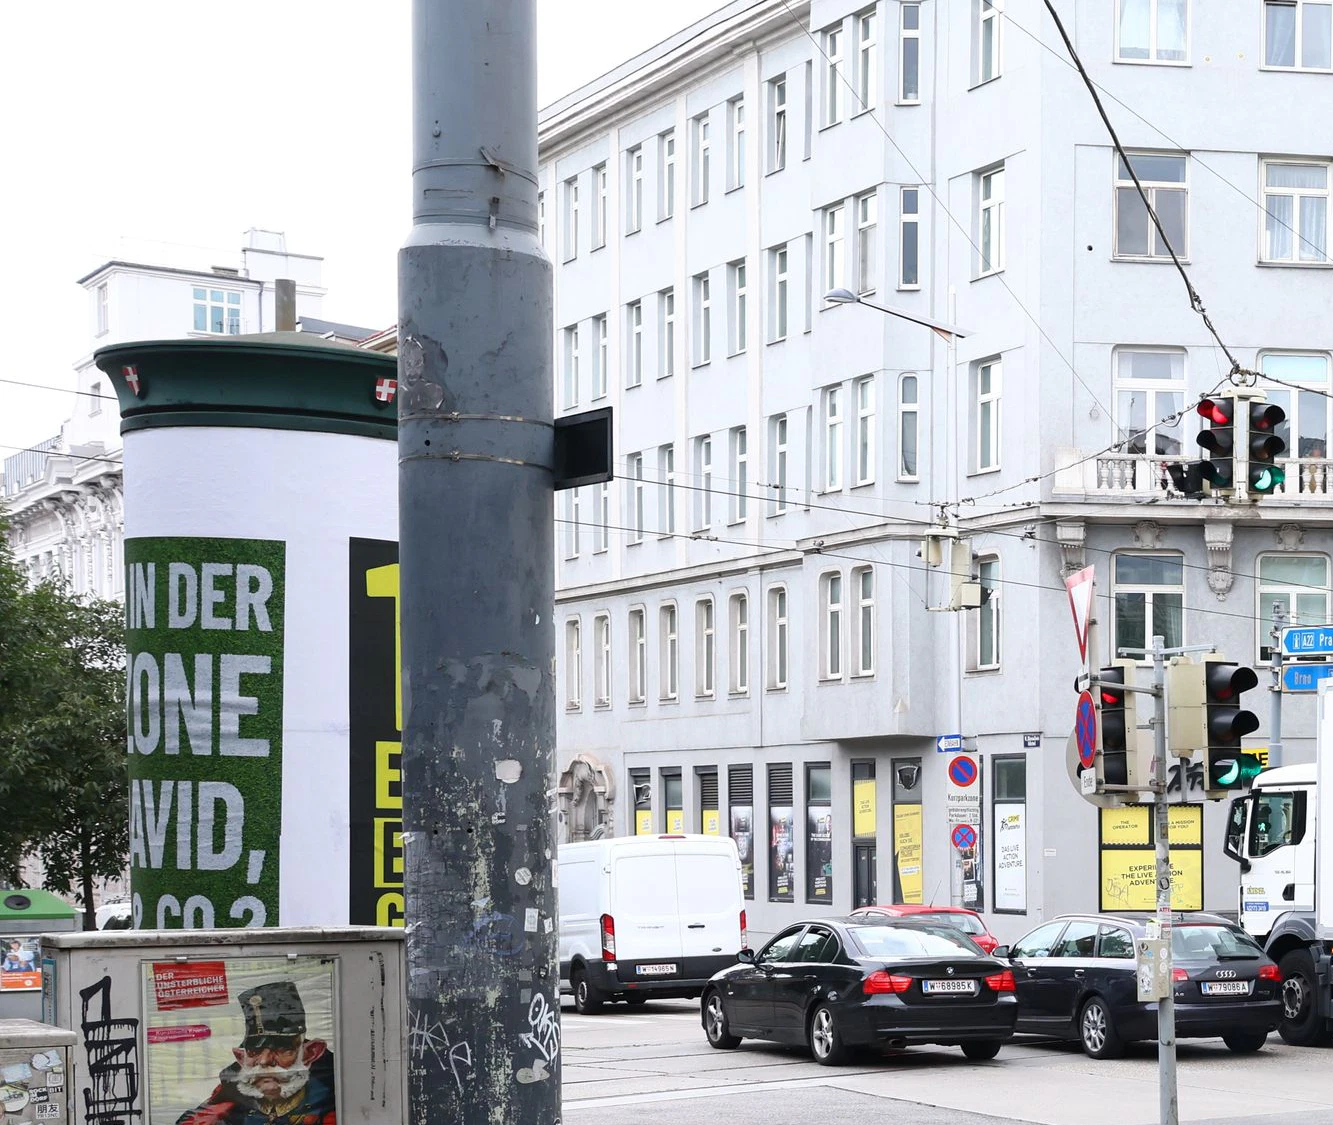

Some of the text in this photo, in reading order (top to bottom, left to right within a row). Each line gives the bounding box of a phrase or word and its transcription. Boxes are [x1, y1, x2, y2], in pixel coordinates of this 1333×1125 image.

[168, 561, 274, 632] DER
[1303, 634, 1314, 647] A22
[1294, 671, 1312, 685] Brno
[1129, 863, 1174, 872] EXPERIE
[156, 972, 174, 981] DER
[157, 975, 225, 989] UNSTERBLICHE
[158, 985, 225, 998] ÖSTERREICHER
[37, 1104, 58, 1114] 朋友
